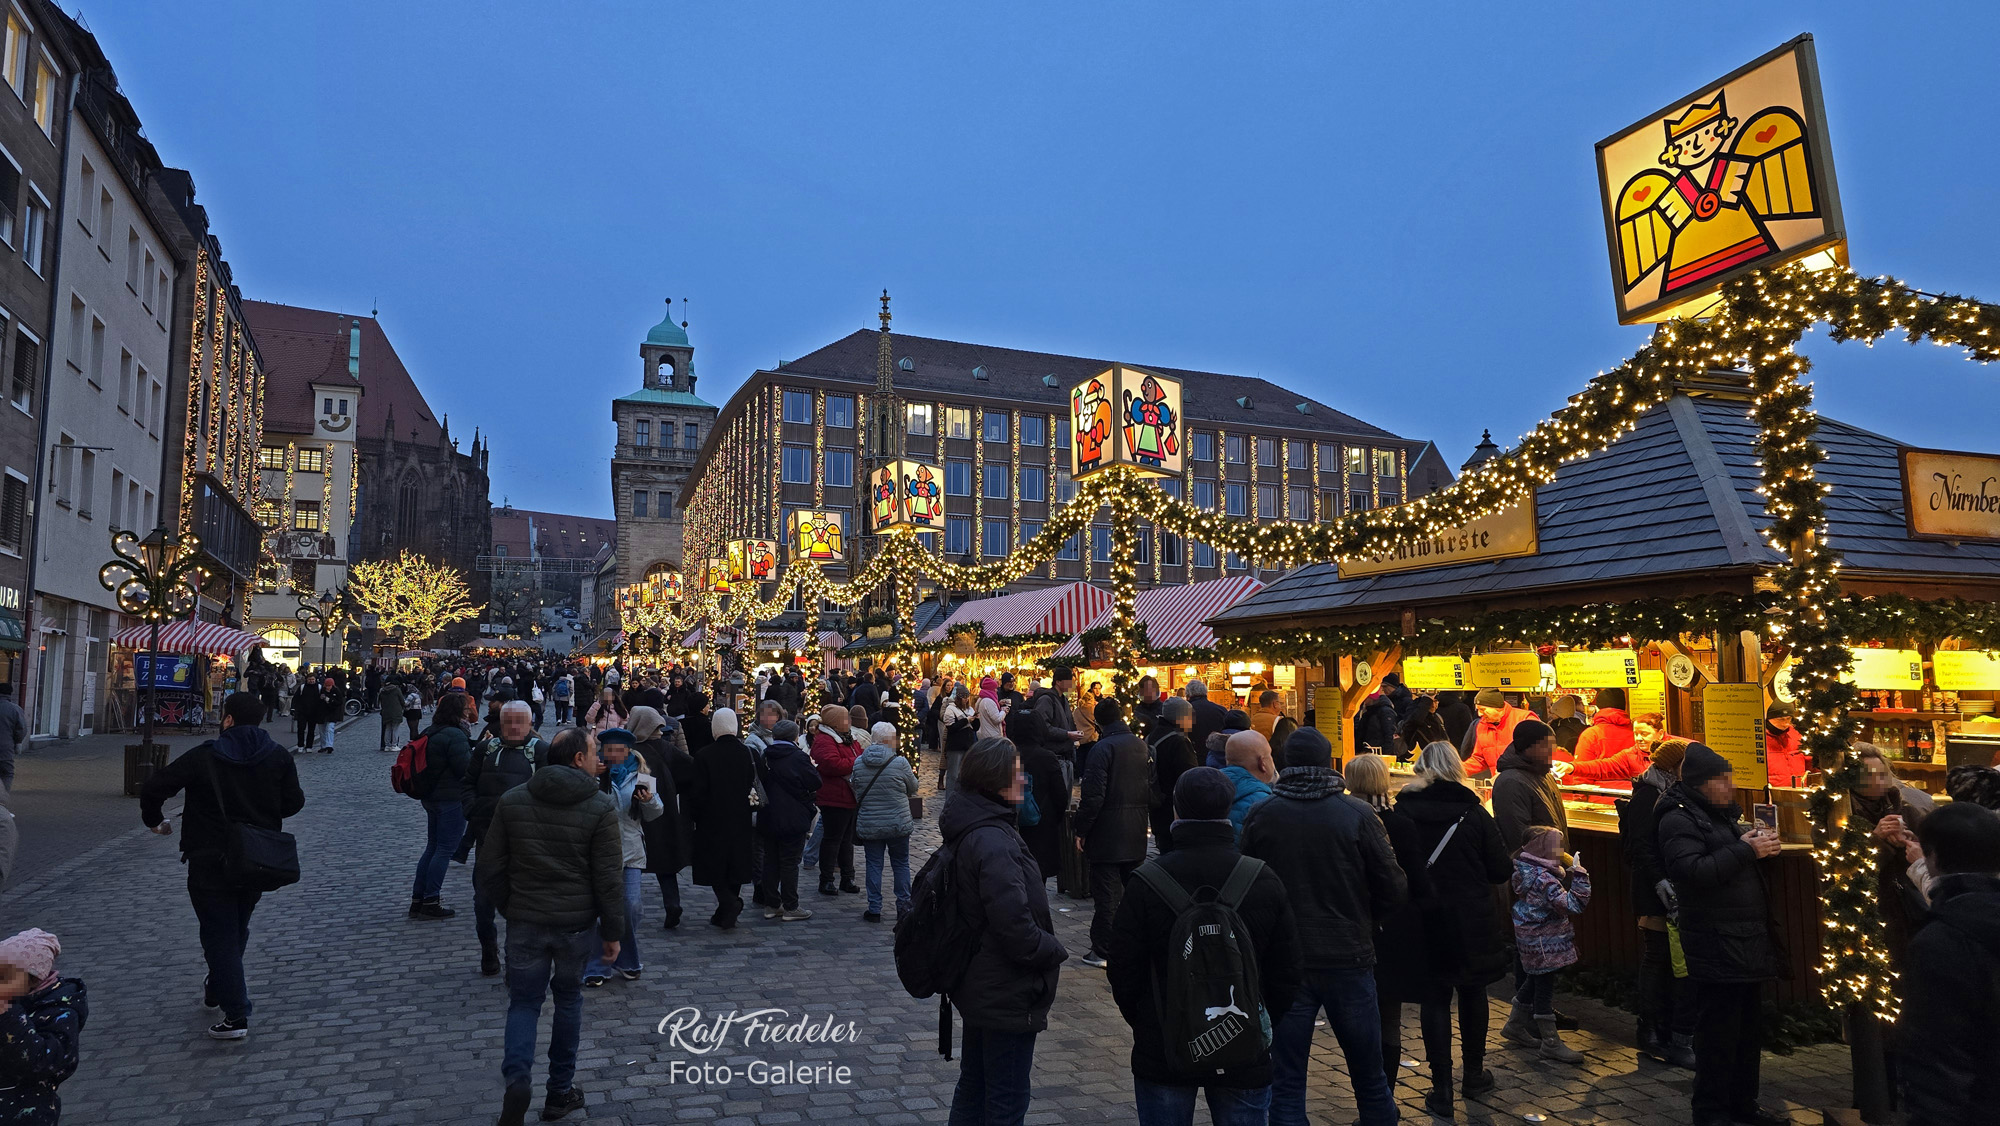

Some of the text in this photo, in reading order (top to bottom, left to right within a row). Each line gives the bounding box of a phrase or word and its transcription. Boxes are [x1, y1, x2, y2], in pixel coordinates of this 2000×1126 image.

[1929, 471, 2000, 514] Nürnbe
[141, 671, 169, 681] Zne
[143, 660, 168, 669] Ber-
[1188, 1014, 1244, 1063] PUMA
